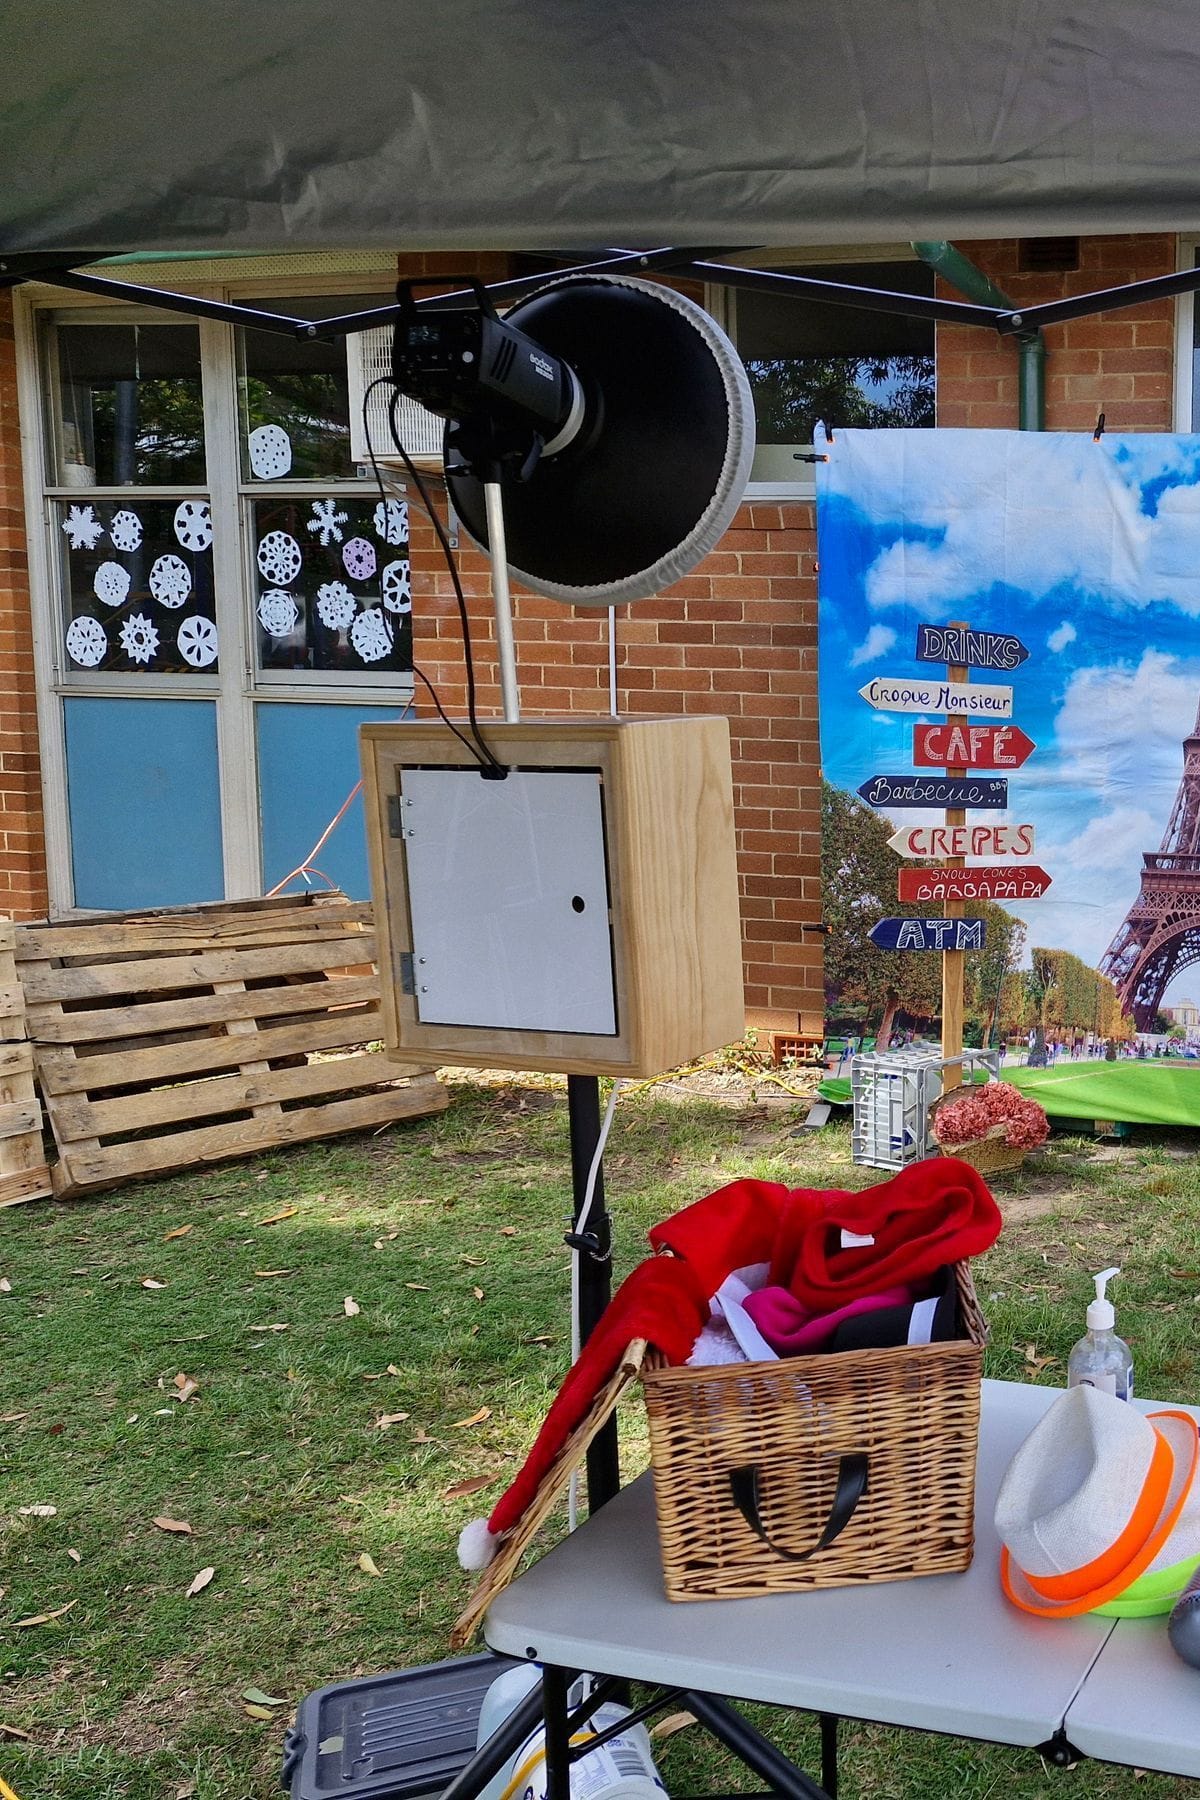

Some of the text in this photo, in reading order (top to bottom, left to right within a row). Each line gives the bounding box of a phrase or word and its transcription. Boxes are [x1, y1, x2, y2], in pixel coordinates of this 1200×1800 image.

[924, 628, 1021, 669] DRINKS
[869, 682, 1010, 710] Croque Monsieur
[923, 725, 1016, 763] CAFÉ
[907, 825, 1033, 856] CREPES
[982, 868, 1027, 880] CONES
[917, 881, 1042, 900] BARBAPAPA
